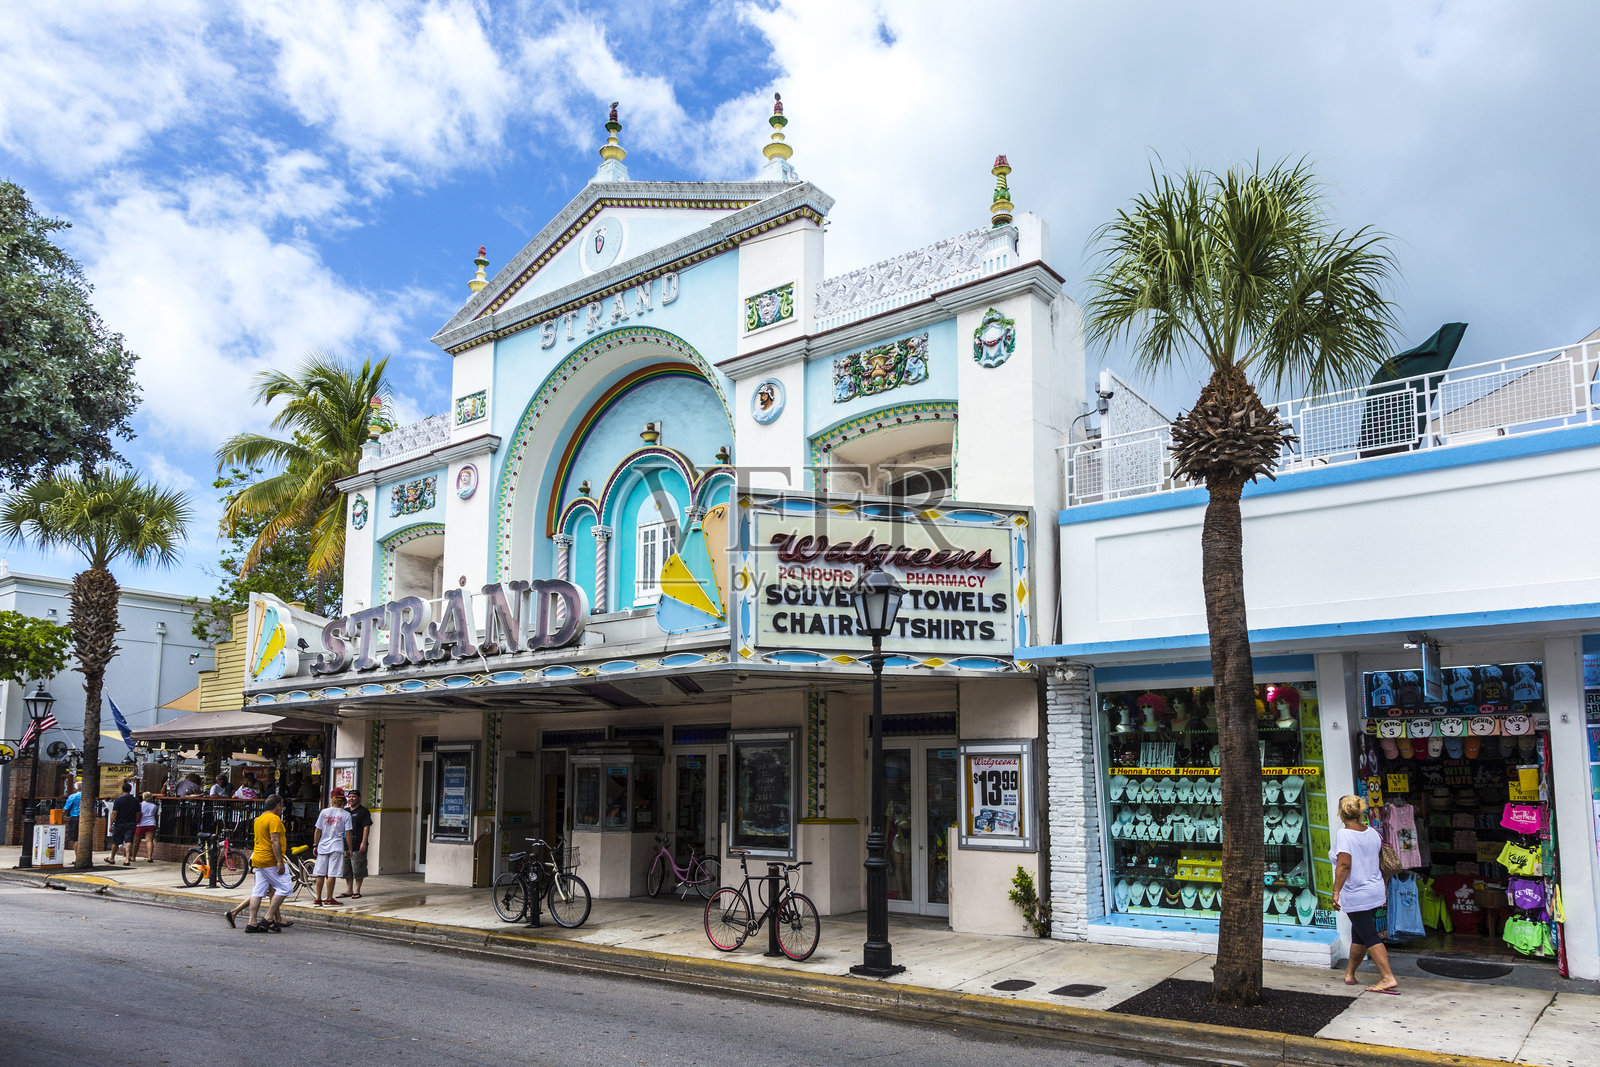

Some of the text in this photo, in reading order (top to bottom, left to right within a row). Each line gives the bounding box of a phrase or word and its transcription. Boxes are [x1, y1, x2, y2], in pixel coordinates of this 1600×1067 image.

[539, 272, 679, 350] STRAND
[770, 532, 1001, 575] Walgreens
[779, 567, 853, 582] 24 HOURS
[906, 572, 986, 588] PHARMACY
[766, 584, 1007, 613] SOUVE TOWELS
[309, 578, 588, 676] STRAND
[896, 617, 995, 640] TSHIRTS
[1486, 688, 1500, 698] 32
[1442, 718, 1462, 726] SEXY
[1508, 715, 1527, 724] BITCH
[1514, 724, 1521, 732] 3
[974, 758, 1018, 768] Walgreens
[1286, 767, 1316, 775] Tattoo
[1444, 766, 1472, 776] WITH
[1316, 917, 1336, 926] WANTE
